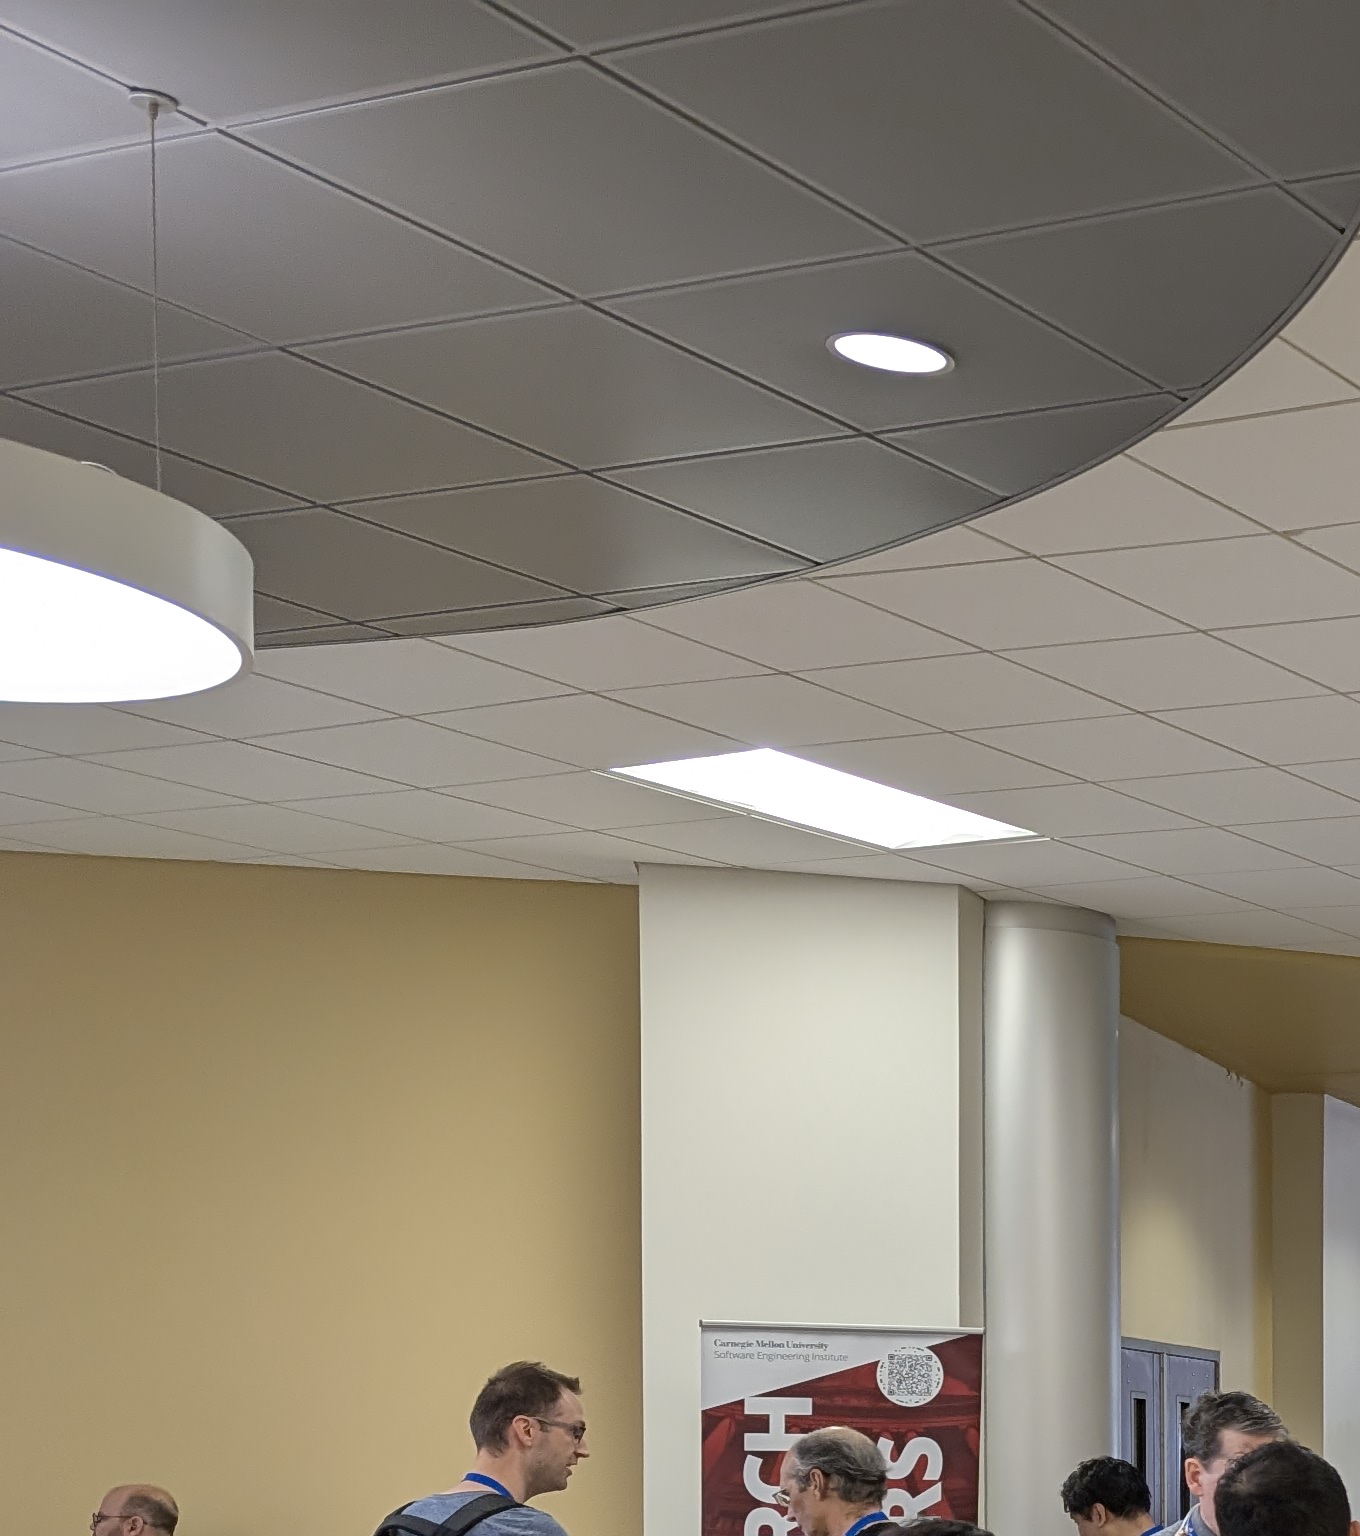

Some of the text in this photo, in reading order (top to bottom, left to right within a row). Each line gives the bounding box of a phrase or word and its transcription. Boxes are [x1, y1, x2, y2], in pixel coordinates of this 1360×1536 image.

[713, 1338, 829, 1351] Carnegie Mellon University
[713, 1350, 849, 1362] Software Engineering Institute
